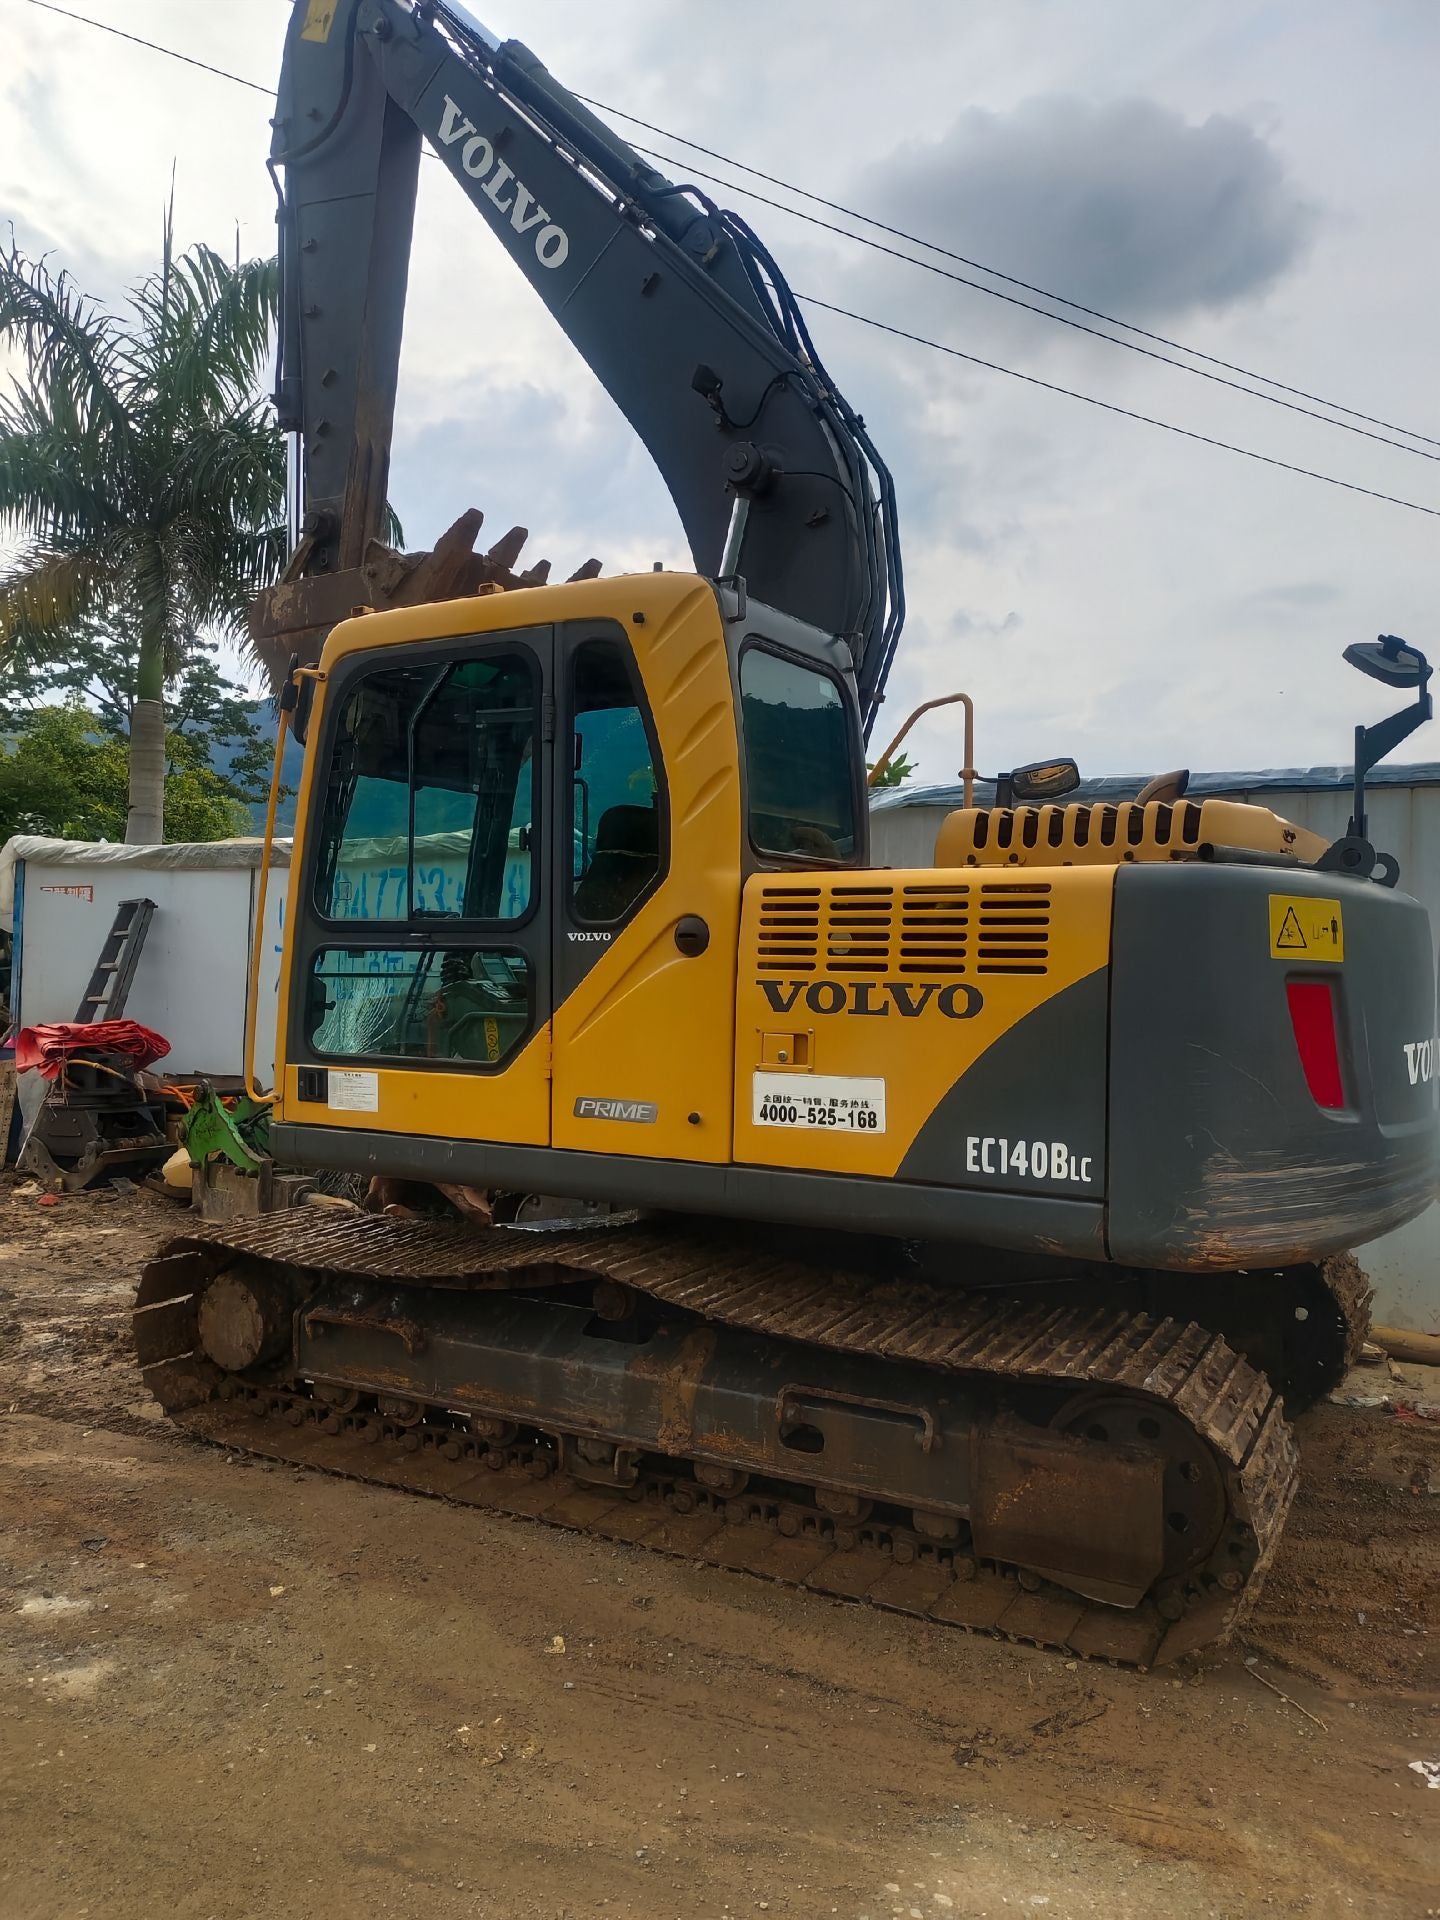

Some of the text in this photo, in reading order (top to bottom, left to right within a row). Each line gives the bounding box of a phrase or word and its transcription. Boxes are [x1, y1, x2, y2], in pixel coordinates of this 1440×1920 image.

[438, 94, 569, 269] VOLVO
[567, 932, 611, 942] VOLVO
[756, 980, 984, 1019] VOLVO
[579, 1100, 653, 1120] PRIME
[759, 1103, 878, 1129] 4000-525-168
